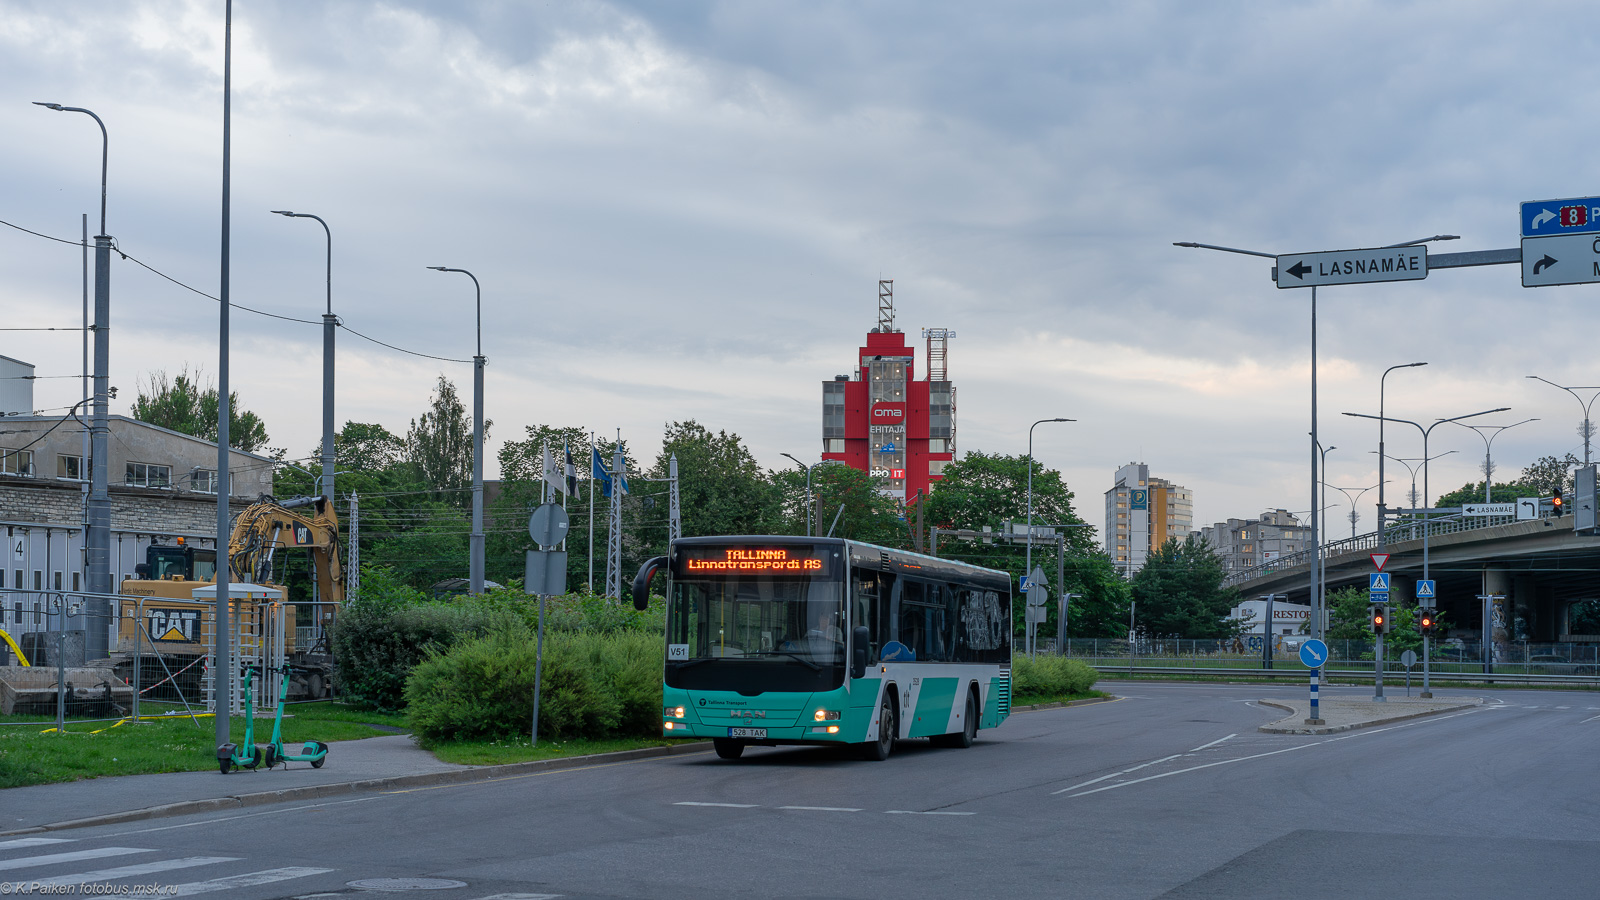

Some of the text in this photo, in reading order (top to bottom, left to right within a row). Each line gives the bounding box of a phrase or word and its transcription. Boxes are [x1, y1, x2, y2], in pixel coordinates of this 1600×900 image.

[1569, 208, 1578, 224] 8
[1319, 253, 1419, 277] LASNAMÄE
[874, 409, 902, 417] oma
[870, 426, 905, 434] EHITAJA
[869, 470, 903, 478] PRO IT
[1477, 505, 1513, 514] LASNAMÄE
[297, 527, 308, 544] CAT
[15, 540, 24, 557] 4
[726, 550, 786, 560] TALLINNA
[688, 559, 822, 569] Linnatranspordi AS
[152, 611, 197, 641] CAT
[670, 647, 685, 656] V51
[730, 709, 766, 718] MAN
[733, 728, 765, 737] 528 TAK
